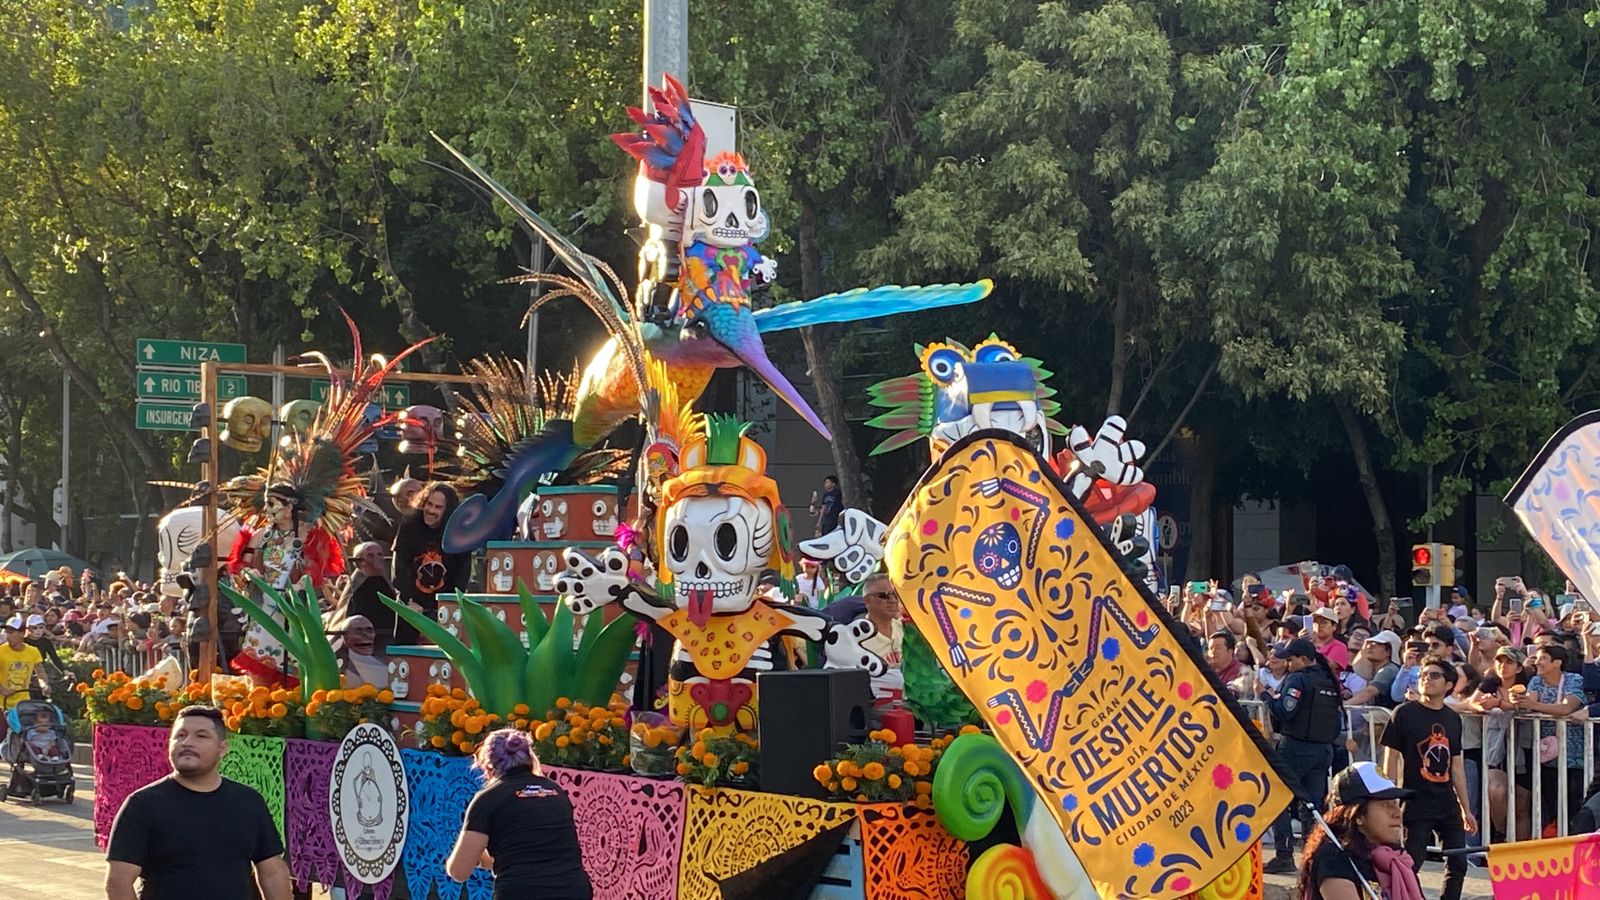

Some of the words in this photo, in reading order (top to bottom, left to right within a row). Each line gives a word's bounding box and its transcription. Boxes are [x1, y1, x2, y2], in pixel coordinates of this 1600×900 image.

[180, 346, 221, 361] NIZA
[161, 378, 181, 393] RIO
[1091, 697, 1121, 729] GRAN
[1070, 679, 1165, 781] DESFILE
[1127, 745, 1148, 766] DÍA
[1089, 711, 1208, 837] MUERTOS
[1116, 807, 1162, 846] CIUDAD
[1163, 792, 1180, 809] DE
[1179, 744, 1215, 791] MÉXICO
[1168, 800, 1196, 829] 2023
